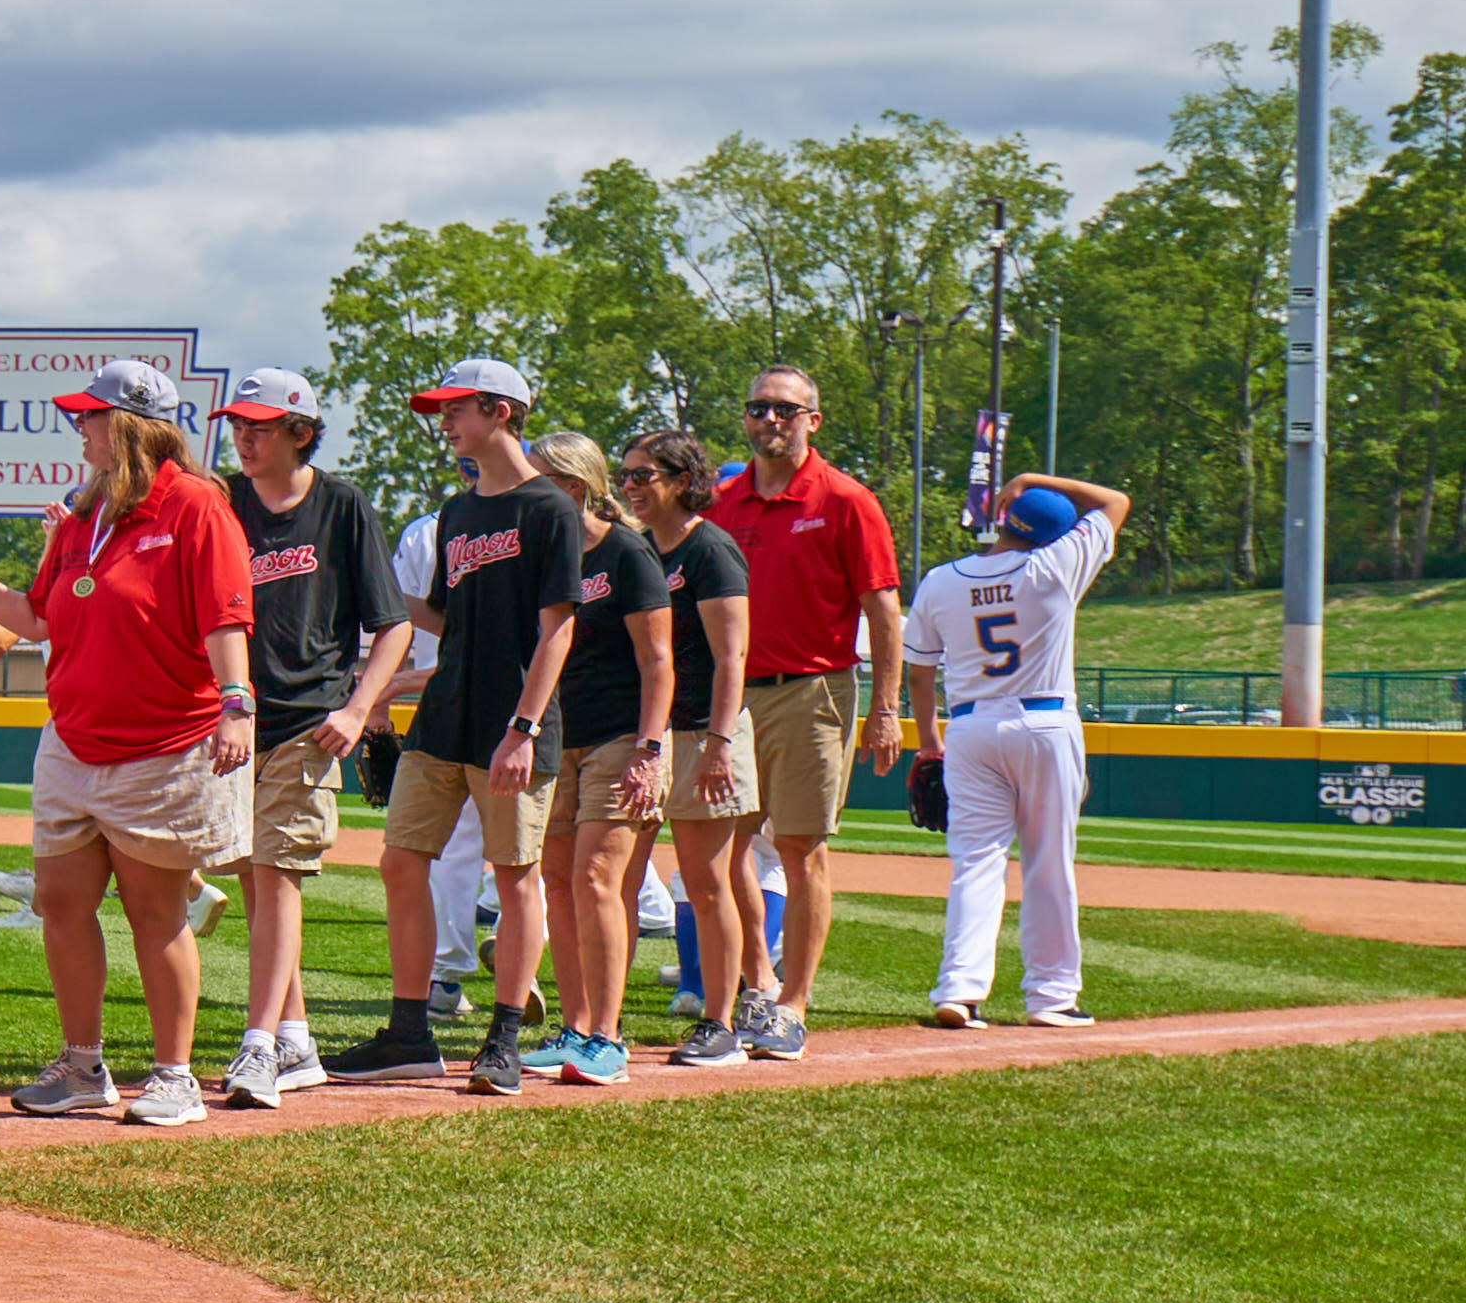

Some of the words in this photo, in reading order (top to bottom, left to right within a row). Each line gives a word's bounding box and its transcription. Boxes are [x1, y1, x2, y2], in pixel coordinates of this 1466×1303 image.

[250, 544, 319, 586] ason
[447, 529, 521, 588] Mason
[970, 584, 1014, 607] RUIZ
[974, 610, 1021, 678] 5
